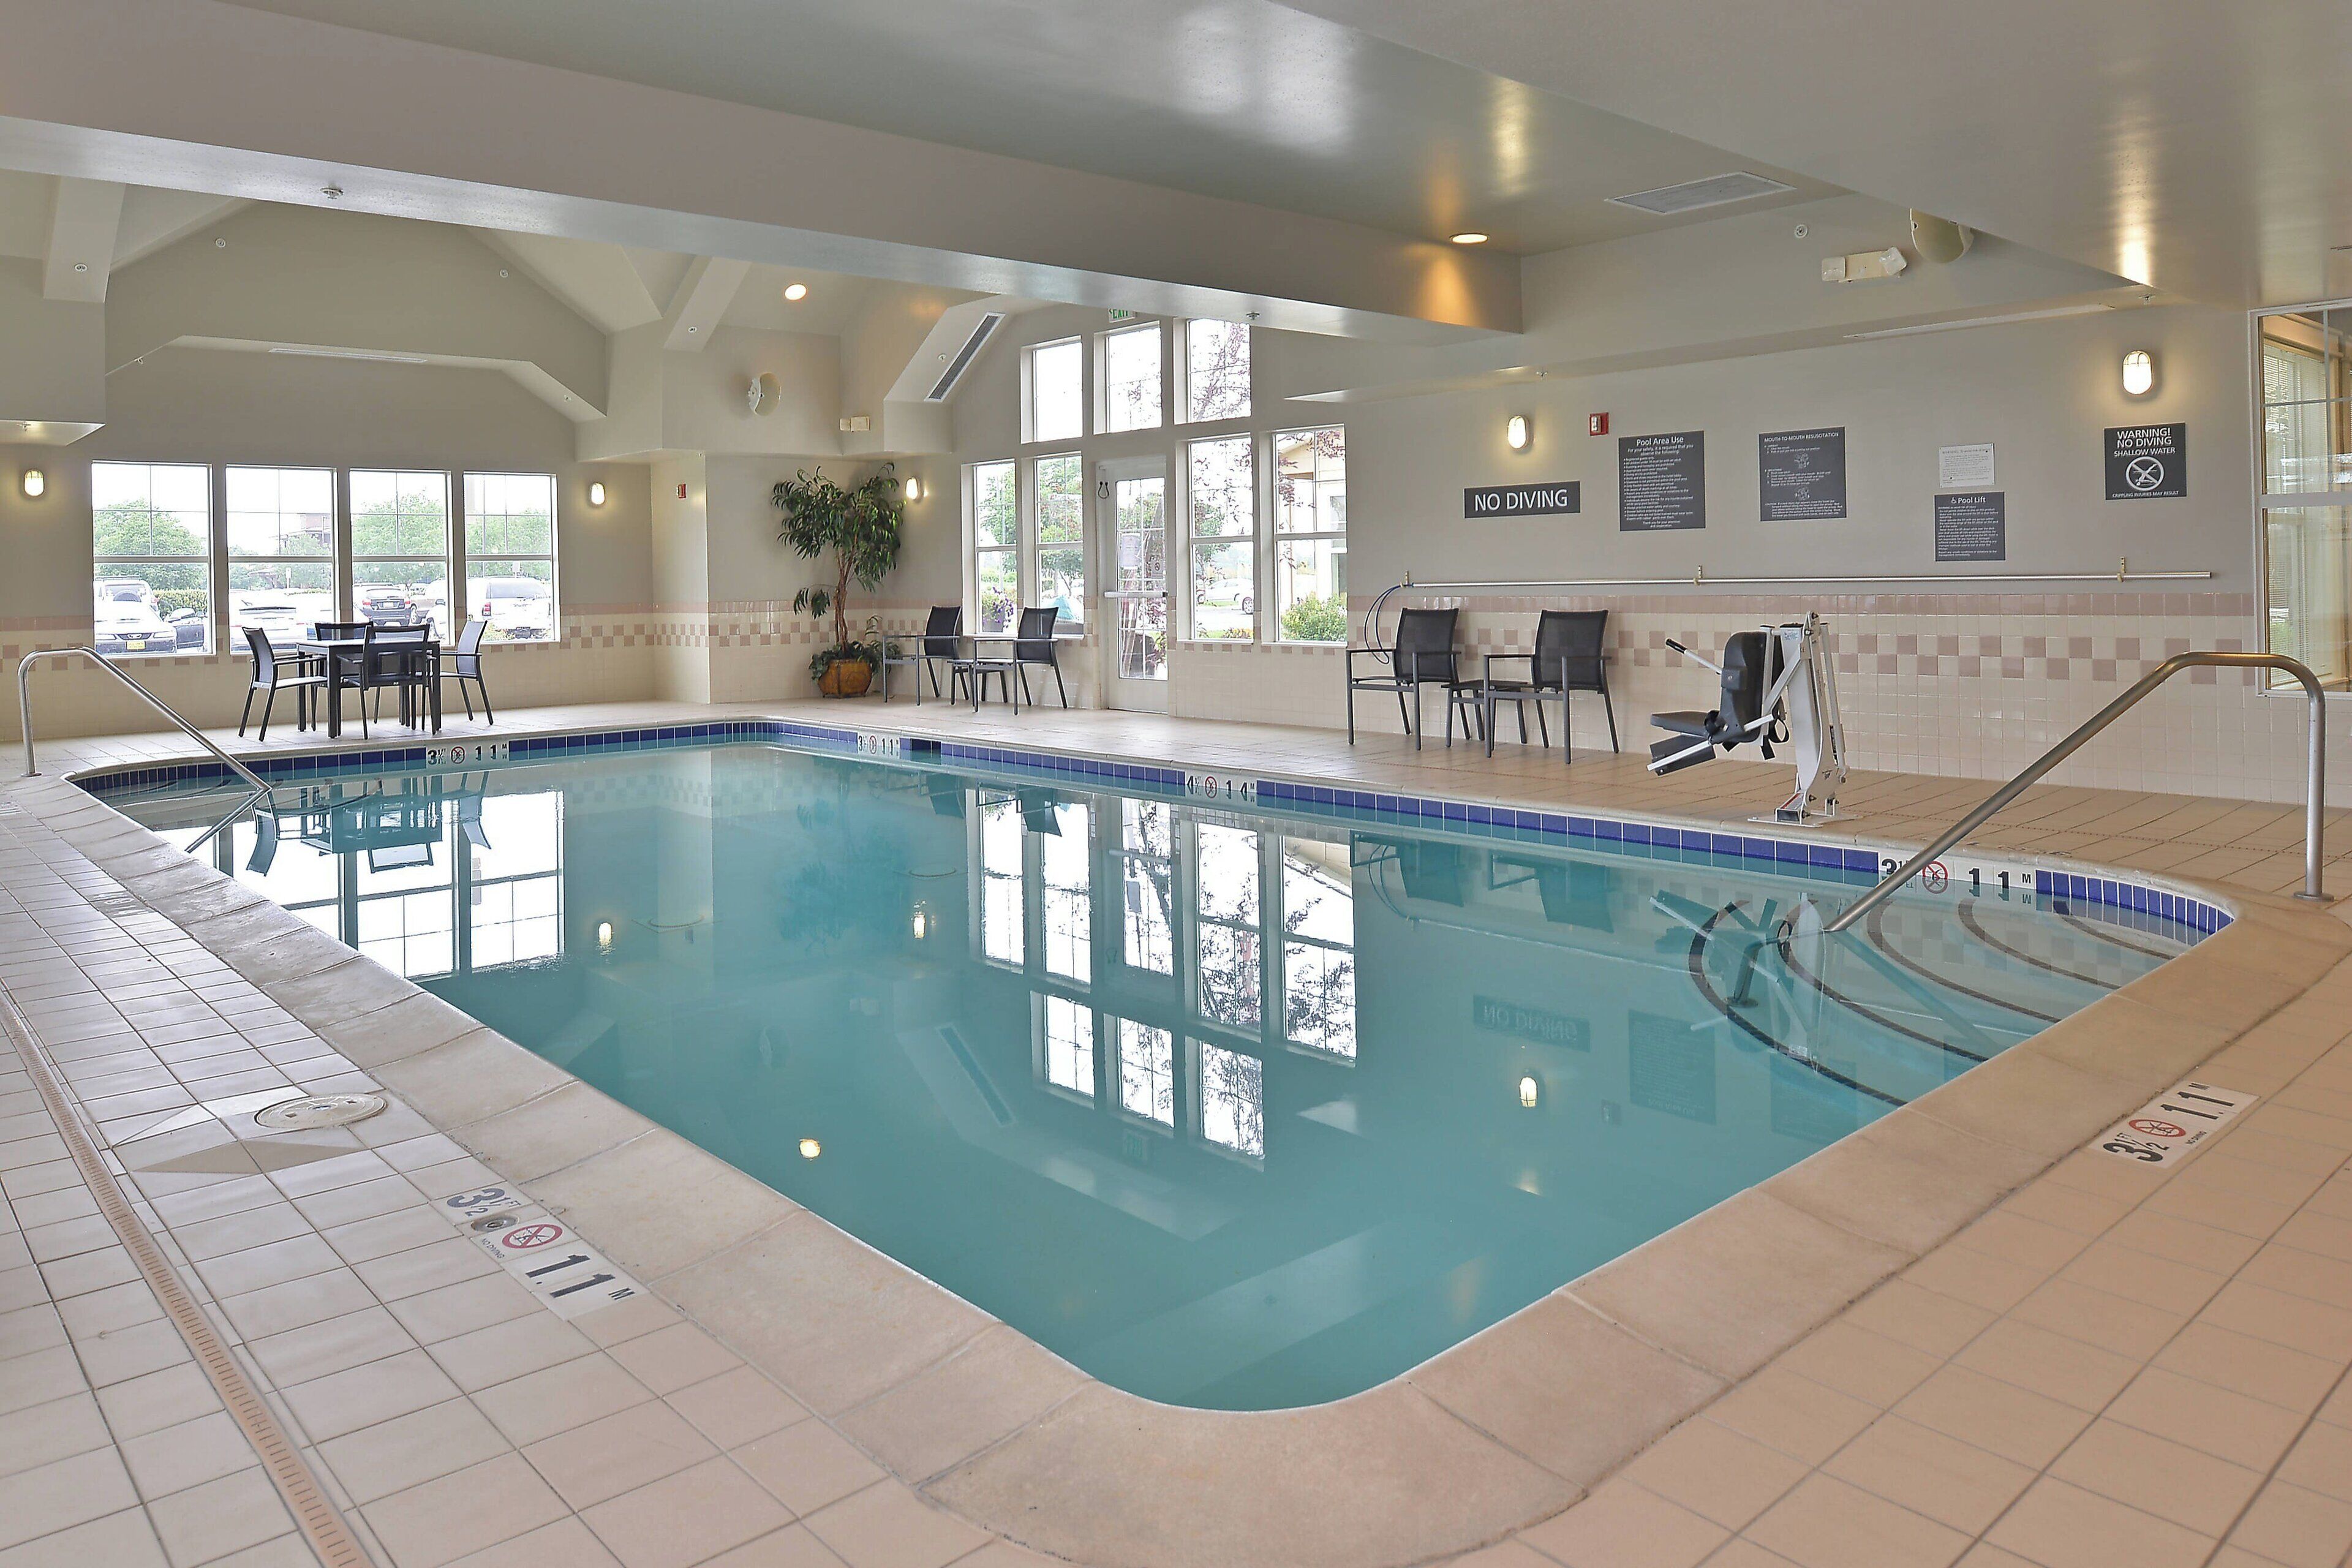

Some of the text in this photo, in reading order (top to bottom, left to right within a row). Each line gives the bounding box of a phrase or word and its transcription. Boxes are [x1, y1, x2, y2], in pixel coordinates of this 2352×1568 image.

[2117, 428, 2171, 440] WARNING!
[1637, 437, 1651, 447] Pool
[2117, 437, 2172, 448] NO DIVING
[2114, 448, 2149, 458] SHALLOW
[1474, 489, 1567, 511] NO DIVING
[2022, 873, 2031, 884] M
[508, 1199, 522, 1208] FT
[608, 1287, 635, 1300] M
